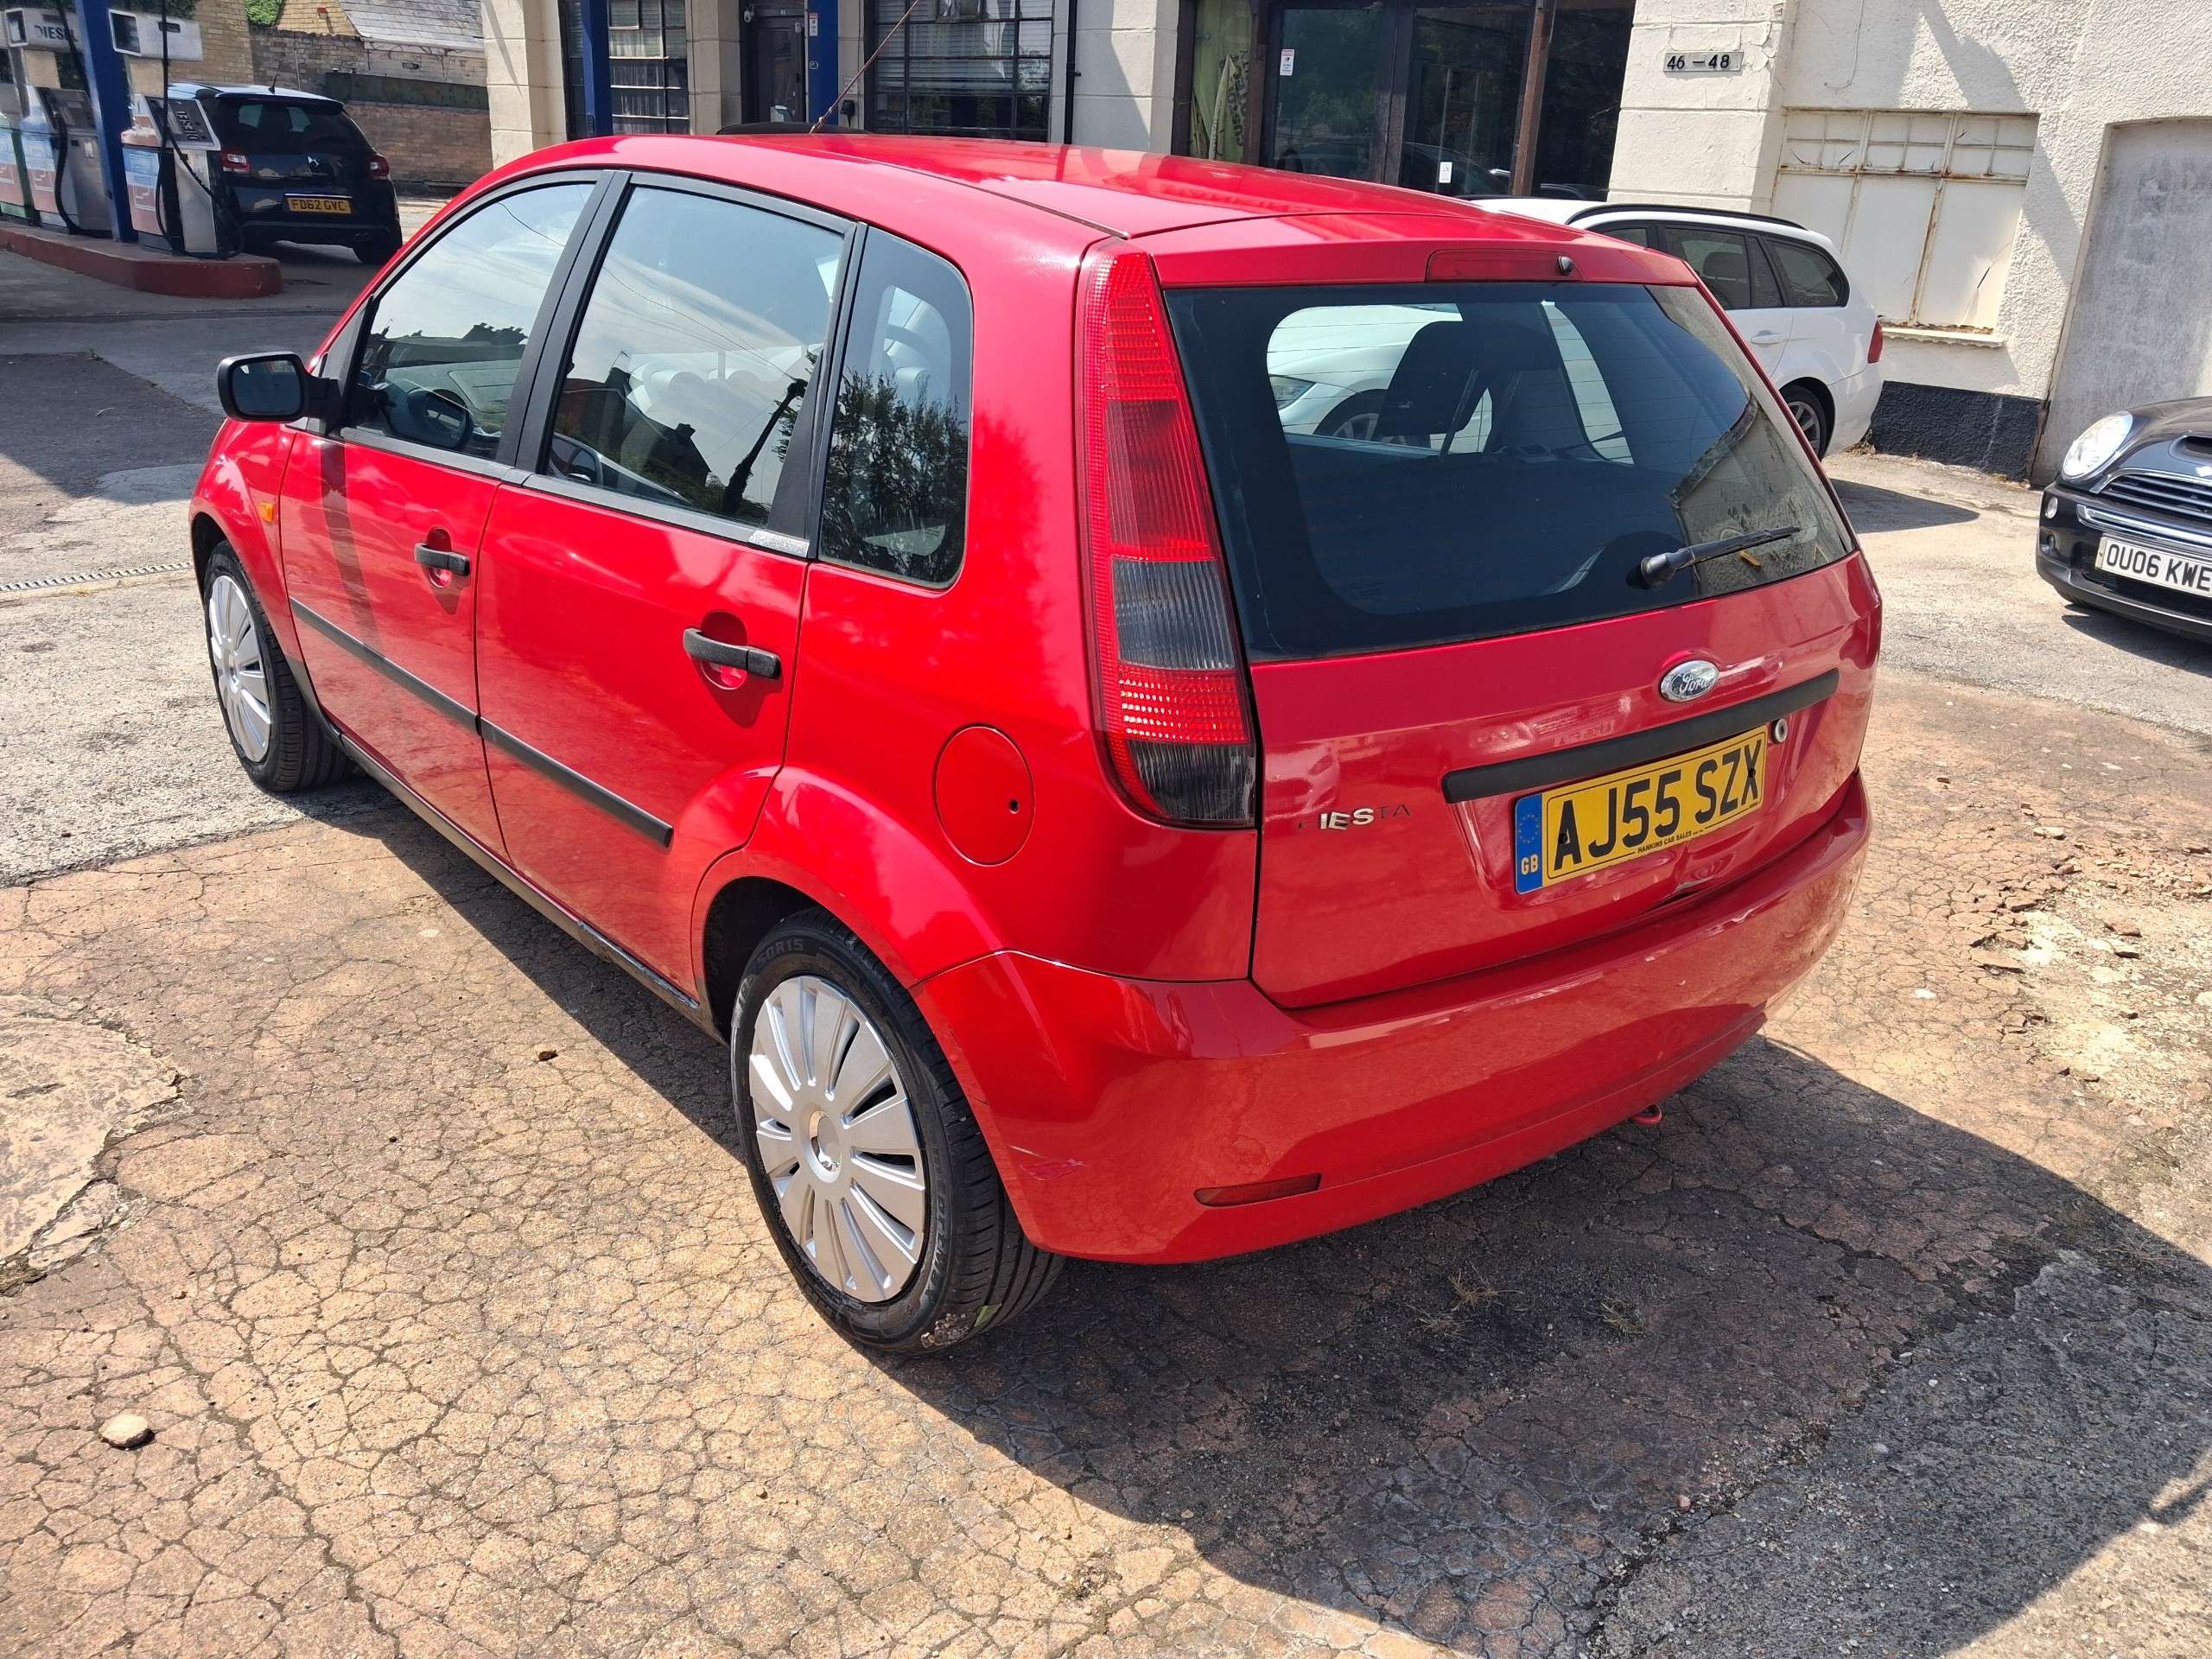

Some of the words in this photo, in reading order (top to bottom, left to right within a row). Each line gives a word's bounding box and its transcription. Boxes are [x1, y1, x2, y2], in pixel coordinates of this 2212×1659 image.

[1667, 55, 1686, 70] 46
[1708, 54, 1730, 69] 48
[175, 110, 200, 141] DIESEL
[290, 199, 322, 210] FD62
[323, 200, 346, 212] GVC
[2106, 543, 2162, 578] OU06
[2164, 558, 2212, 592] KWE
[1553, 769, 1682, 872] AJ55
[1694, 739, 1763, 825] SZX
[1637, 842, 1663, 854] HANKINS
[1664, 836, 1675, 846] CAR
[1676, 830, 1693, 841] SALES
[1521, 854, 1539, 876] GB
